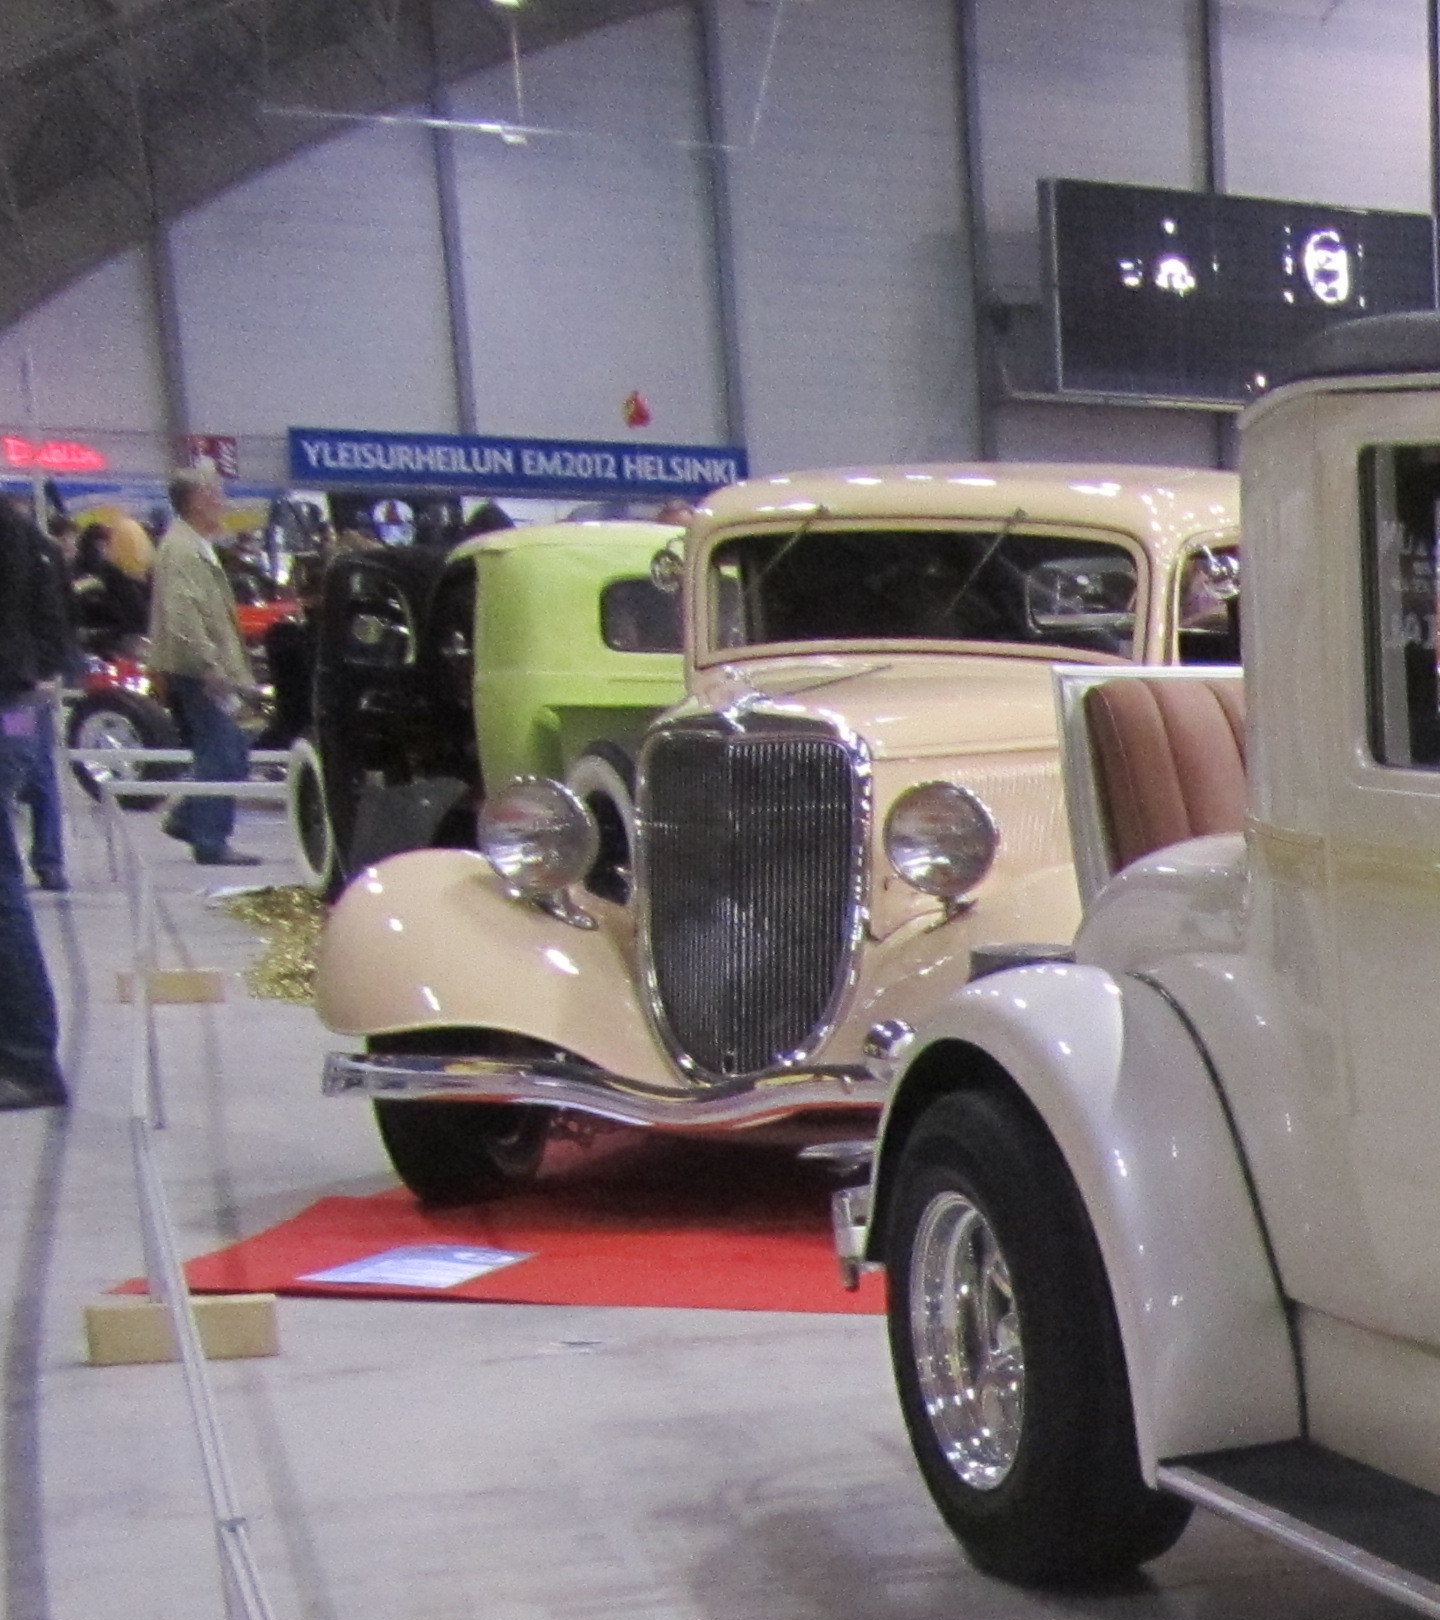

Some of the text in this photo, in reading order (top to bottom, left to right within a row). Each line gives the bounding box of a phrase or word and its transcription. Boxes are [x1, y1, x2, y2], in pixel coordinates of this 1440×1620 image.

[300, 440, 736, 484] YLEISURHEILUN EM2012 HELSINKI
